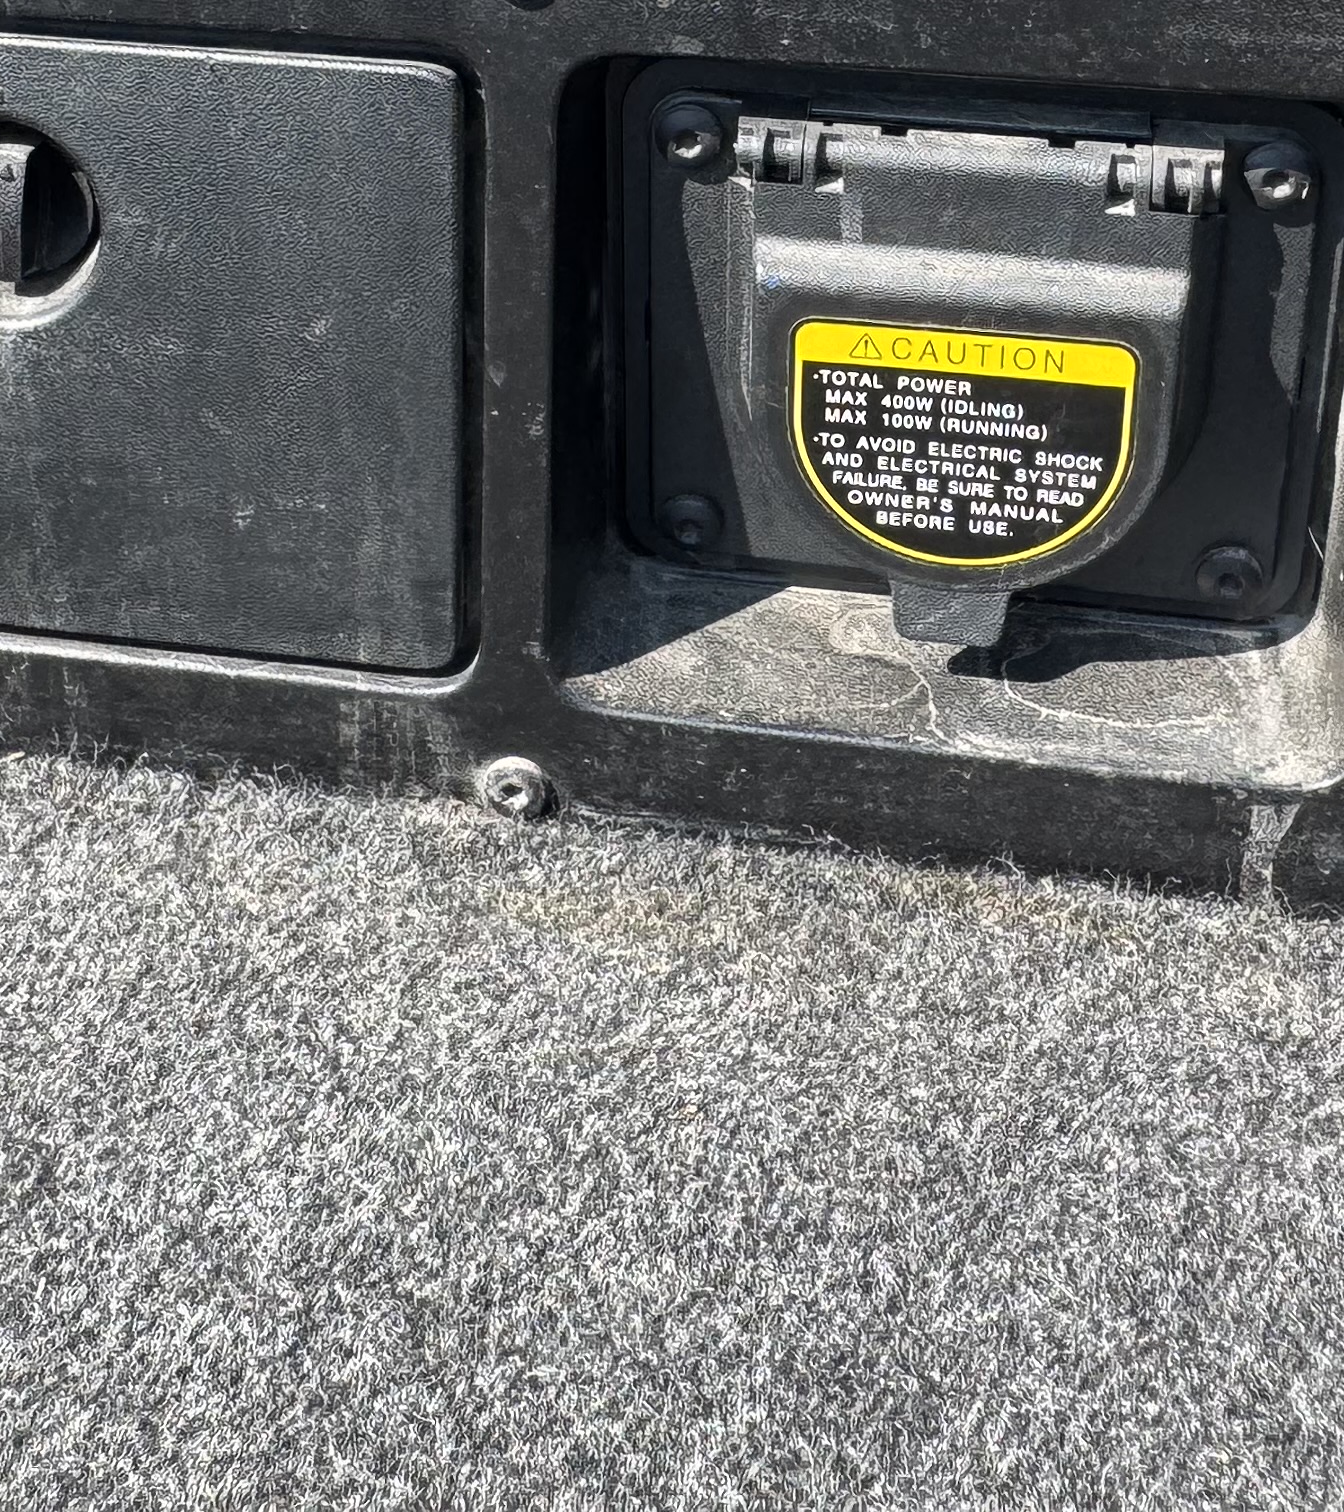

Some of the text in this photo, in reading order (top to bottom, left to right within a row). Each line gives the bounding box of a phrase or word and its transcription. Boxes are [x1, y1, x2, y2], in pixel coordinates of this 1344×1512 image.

[891, 337, 1065, 374] CAUTION
[897, 376, 972, 396] POWER
[825, 389, 1024, 420] MAX 400W (IDLING)
[825, 407, 1048, 441] MAX 100W (RUNNING)
[822, 451, 1097, 489] AND ELECTRICAL SYSTEM
[856, 436, 916, 454] AVOID
[928, 442, 1022, 464] ELECTRIC
[1035, 453, 1103, 471] SHOCK
[847, 489, 1064, 524] OWNER'S MANUAL
[916, 479, 939, 494] BE
[948, 479, 994, 499] SURE
[1004, 486, 1028, 501] TO
[1037, 488, 1084, 507] READ
[876, 510, 1014, 537] BEFORE USE.
